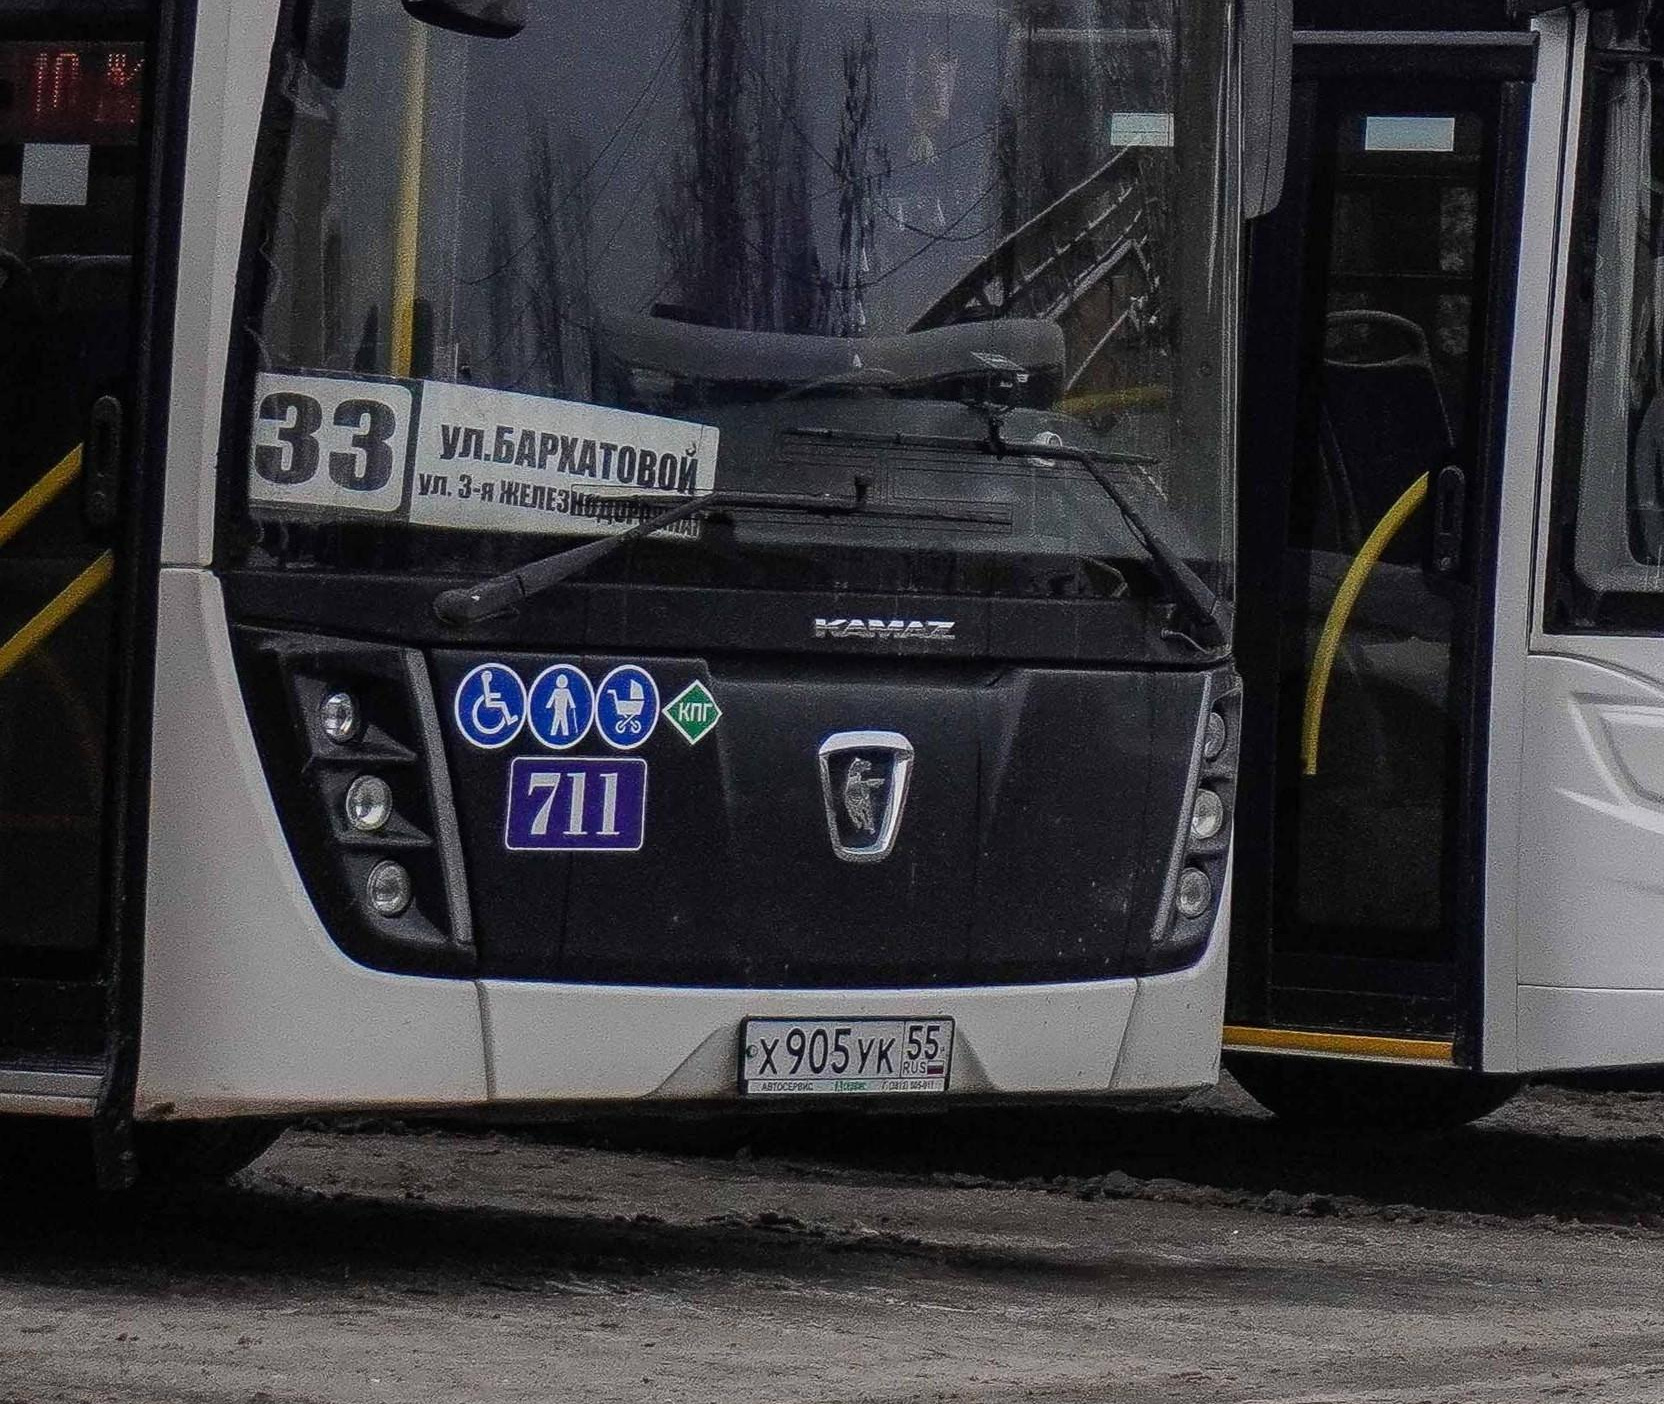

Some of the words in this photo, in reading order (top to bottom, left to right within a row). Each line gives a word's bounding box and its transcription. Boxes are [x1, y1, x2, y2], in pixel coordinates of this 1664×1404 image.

[254, 392, 396, 492] 33
[678, 700, 713, 723] КПГ
[528, 772, 620, 836] 711
[907, 1025, 940, 1060] 55
[902, 1060, 926, 1075] RUS
